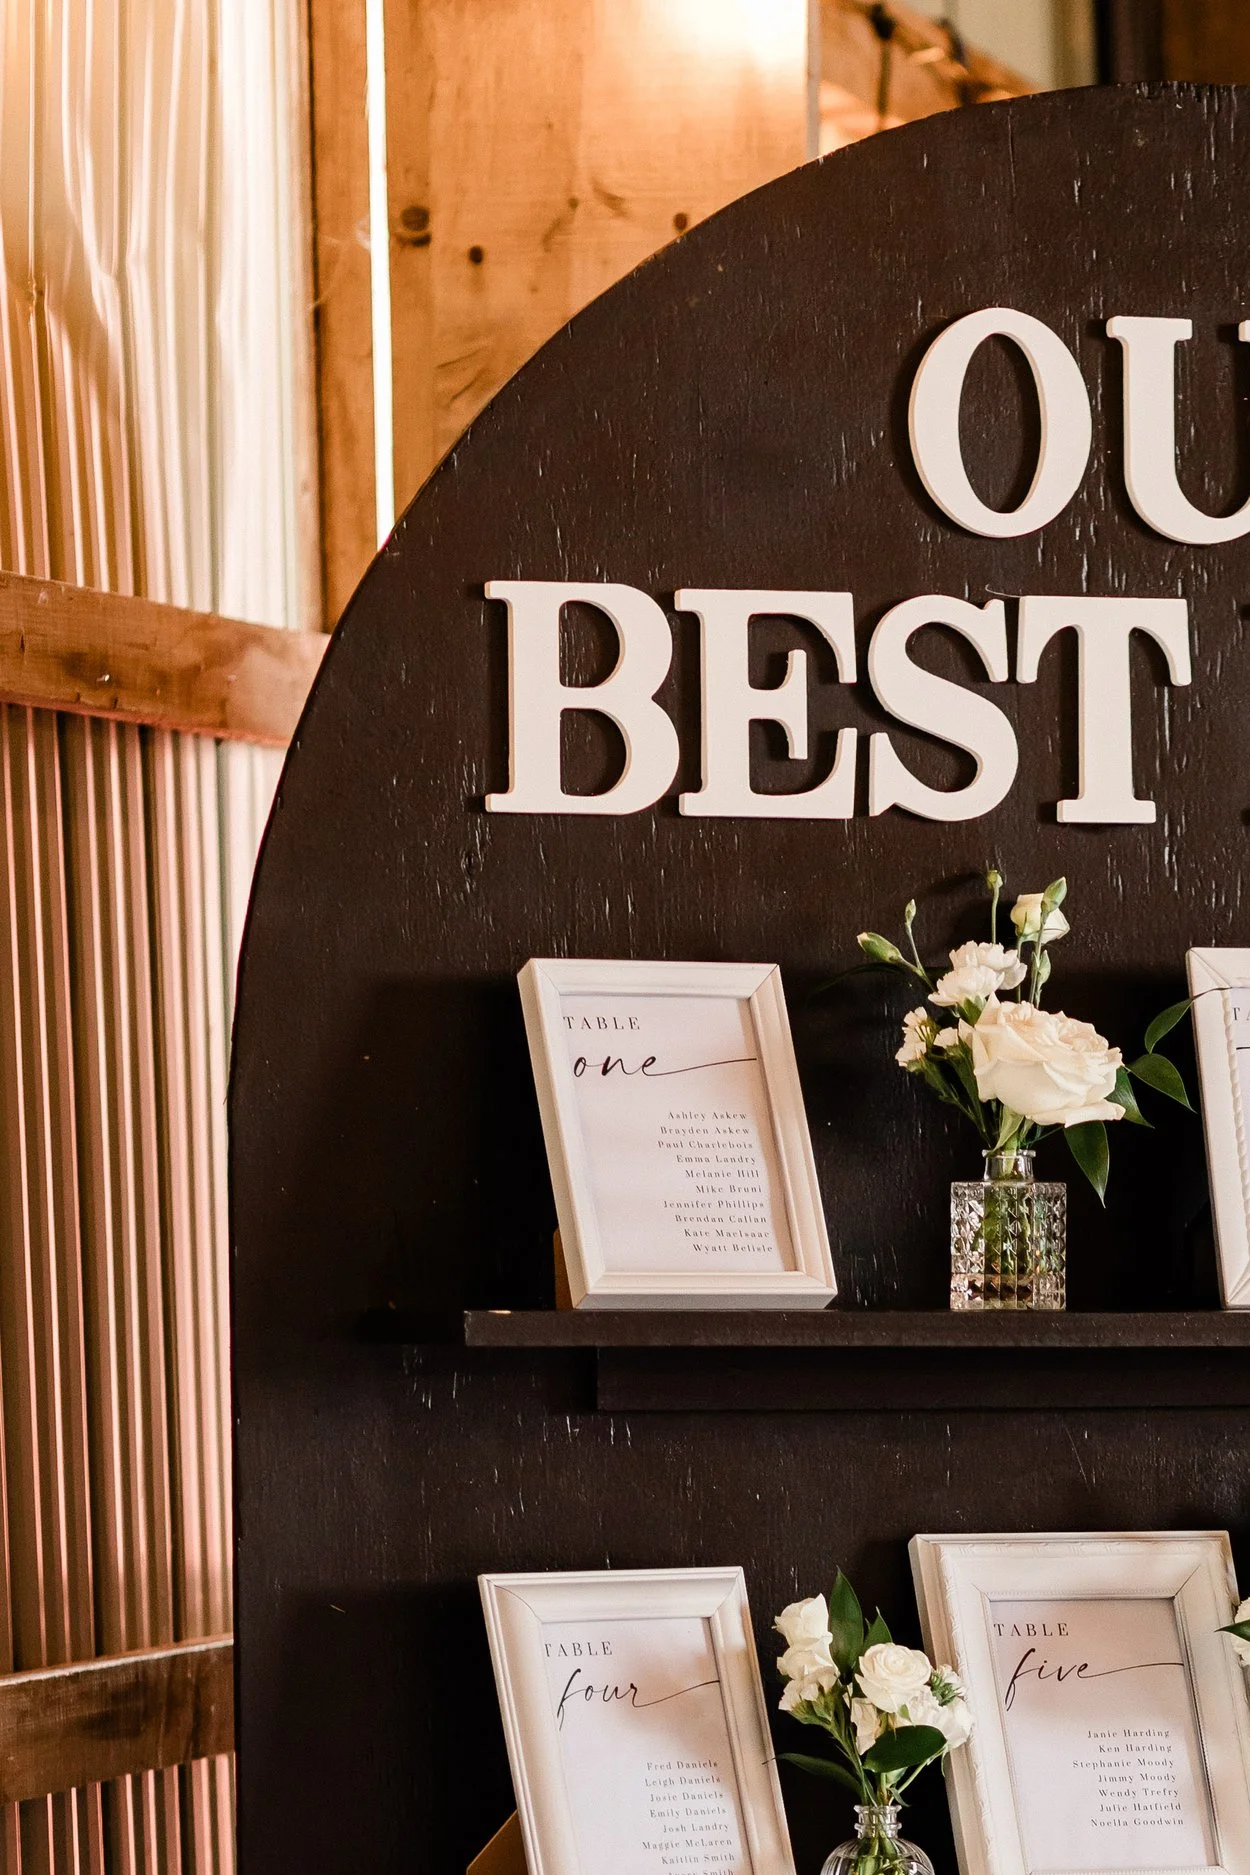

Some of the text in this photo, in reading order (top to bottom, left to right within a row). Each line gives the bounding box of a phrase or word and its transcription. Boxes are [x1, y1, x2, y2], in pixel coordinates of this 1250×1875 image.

[484, 580, 1193, 825] BEST
[563, 1016, 640, 1030] TABLE
[574, 1055, 757, 1077] one
[668, 1111, 748, 1121] Ashley Askew
[660, 1126, 709, 1136] Brayden
[689, 1141, 753, 1149] Charlebois
[677, 1155, 756, 1165] Emma Landry
[686, 1170, 731, 1178] Melanie
[718, 1201, 764, 1210] Phillips
[685, 1229, 710, 1237] Kate
[693, 1244, 727, 1254] Wyatt
[994, 1623, 1069, 1637] TABLE
[1005, 1648, 1184, 1711] five
[557, 1669, 720, 1731] four
[1088, 1729, 1170, 1738] Janie Harding
[1099, 1744, 1172, 1753] Ken Harding
[647, 1760, 717, 1771] Fred Daniels
[1073, 1758, 1173, 1770] Stephanie Moody
[645, 1776, 720, 1787] Leigh Daniels
[1099, 1773, 1176, 1783] Jimmy Moody
[650, 1792, 724, 1802] Josie Daniels
[1099, 1789, 1136, 1798] Wendy
[1100, 1802, 1181, 1812] Julie Hatfield
[650, 1807, 727, 1819] Emily Daniels
[663, 1823, 728, 1833] Josh Landry
[1091, 1819, 1128, 1827] Noella
[642, 1839, 732, 1850] Maggie McLaren
[661, 1853, 735, 1864] Kaitlin Smith
